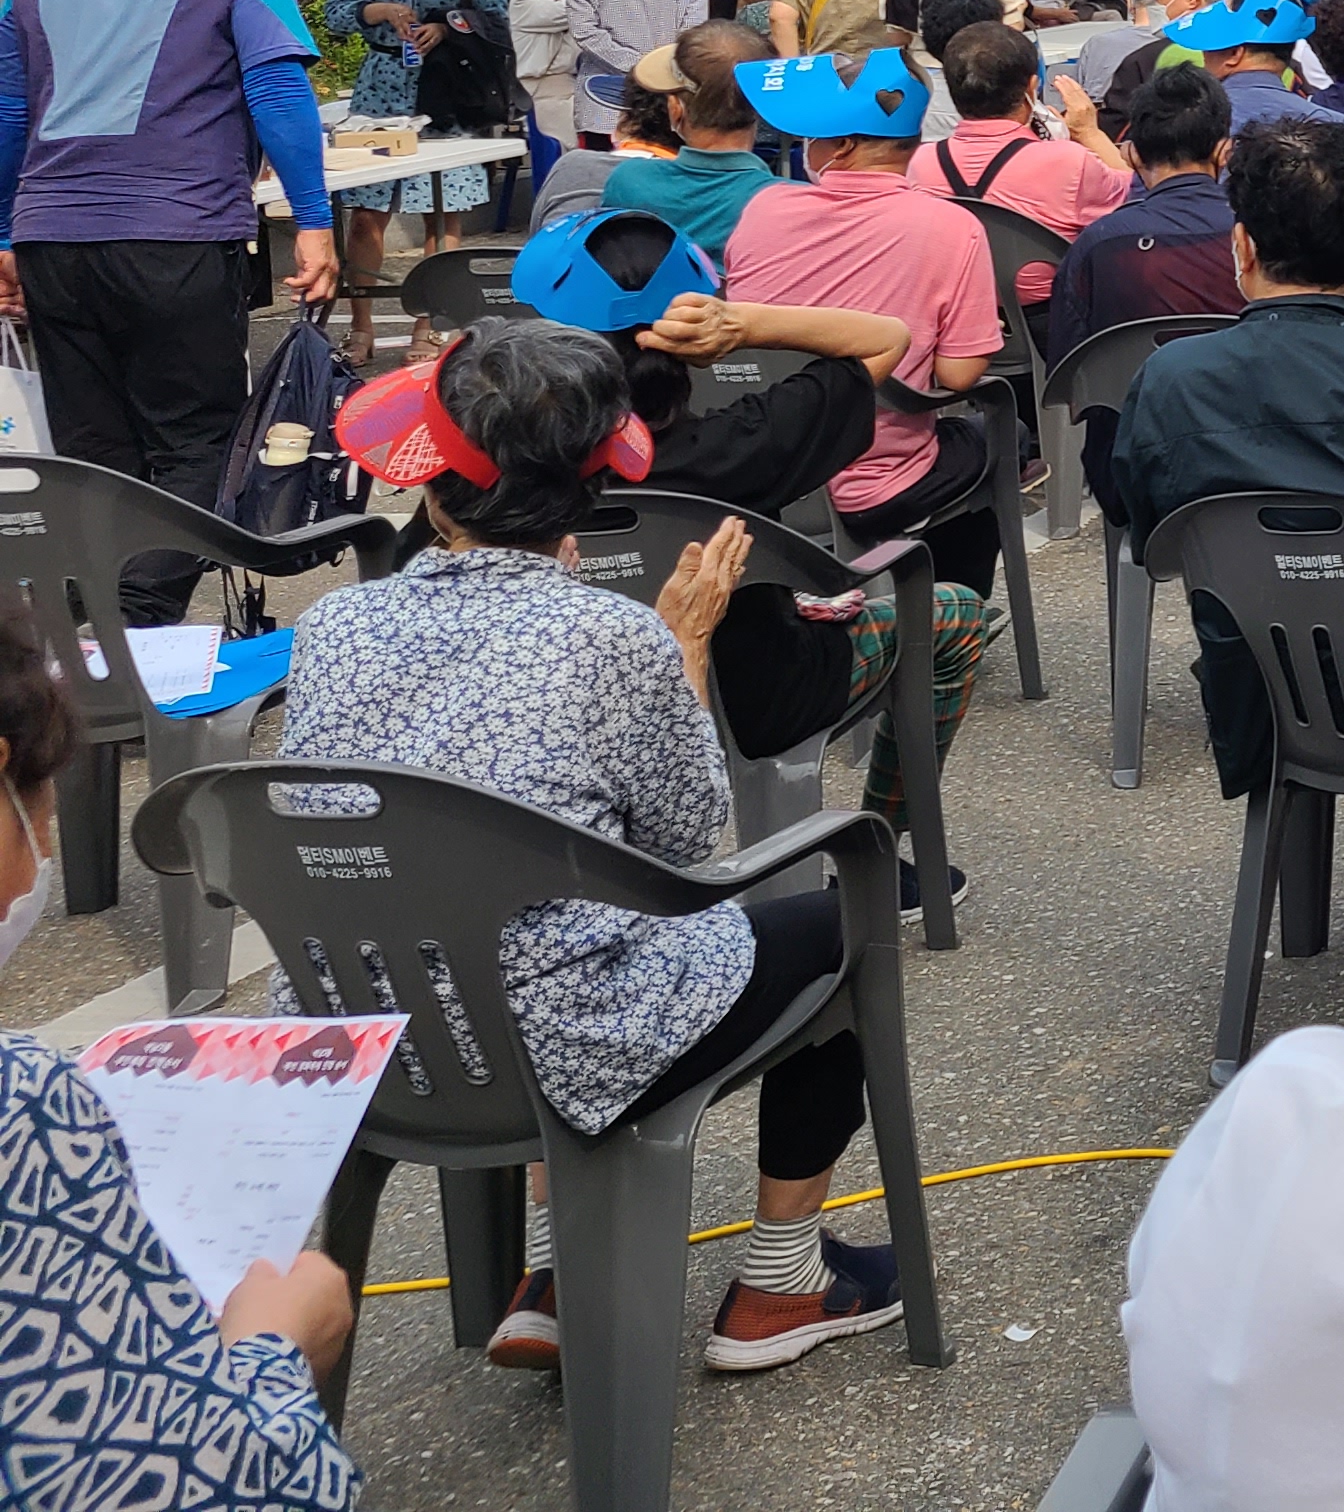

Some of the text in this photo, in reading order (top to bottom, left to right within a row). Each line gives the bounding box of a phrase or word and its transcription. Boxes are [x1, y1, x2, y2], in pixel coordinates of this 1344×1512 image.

[1275, 554, 1344, 570] 멀티SM이벤트
[1280, 568, 1344, 580] 010-4225-9916
[297, 846, 389, 866] 멀티SM이벤트
[306, 866, 393, 879] 010-4225-9916
